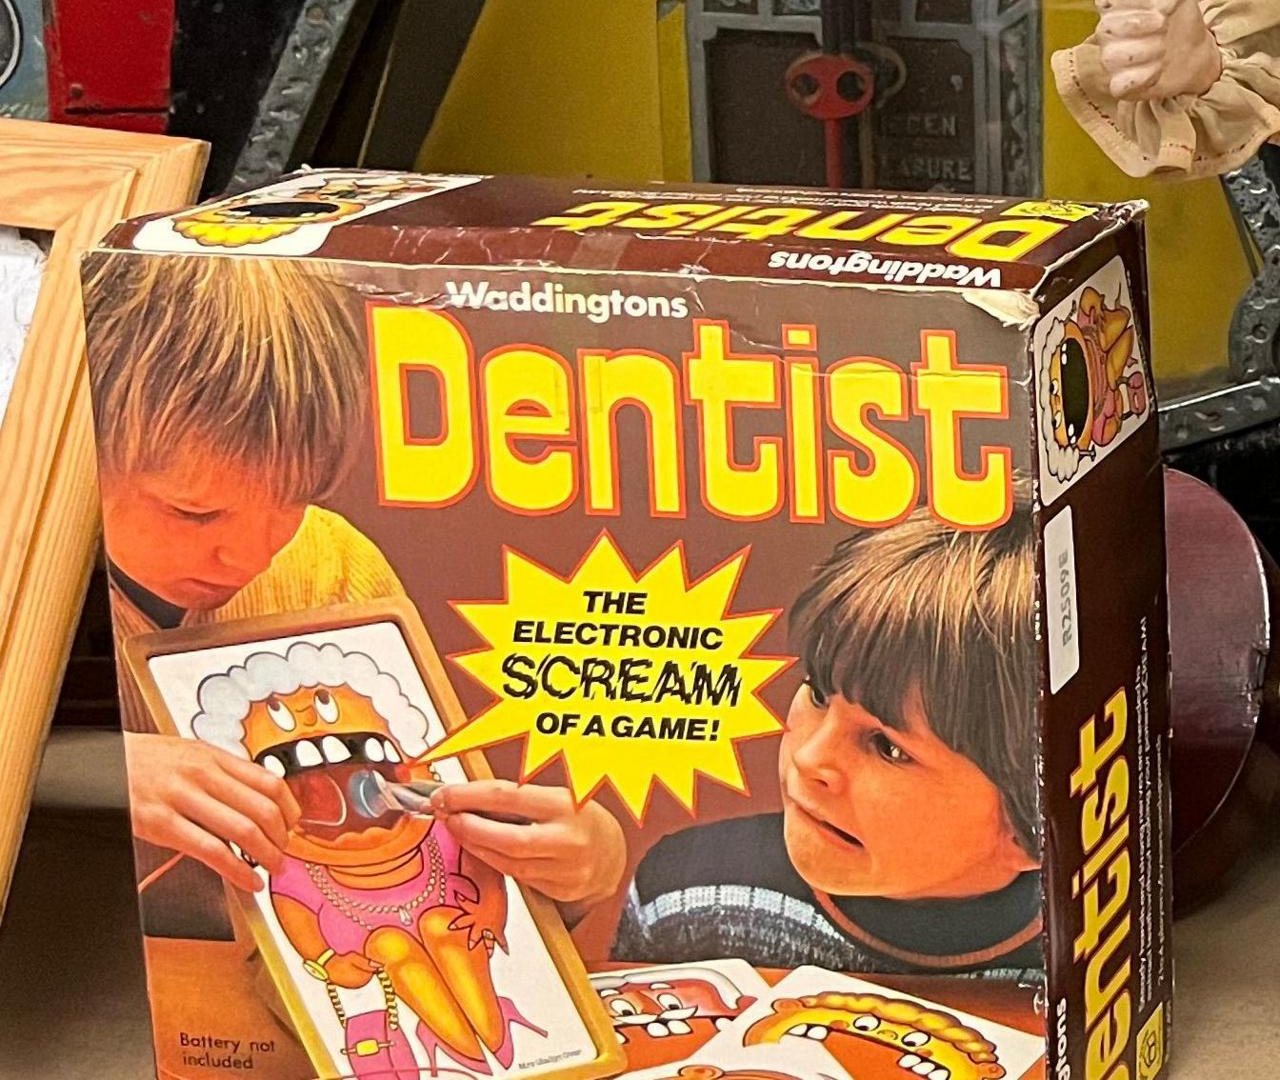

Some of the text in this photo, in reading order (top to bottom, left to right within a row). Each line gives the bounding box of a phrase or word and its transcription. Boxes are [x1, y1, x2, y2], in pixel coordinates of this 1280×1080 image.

[532, 200, 1068, 261] Dentist
[768, 249, 1003, 288] Waddingtons
[445, 281, 690, 324] Waddingtons
[364, 299, 1012, 531] Dentist
[582, 590, 648, 615] THE
[512, 620, 724, 650] ELECTRONIC
[501, 652, 743, 708] SCREAM
[535, 712, 720, 742] OF A GAME!
[1070, 686, 1132, 1080] entist
[180, 1031, 275, 1054] Battery not
[1056, 997, 1072, 1080] gtons
[183, 1051, 254, 1069] included
